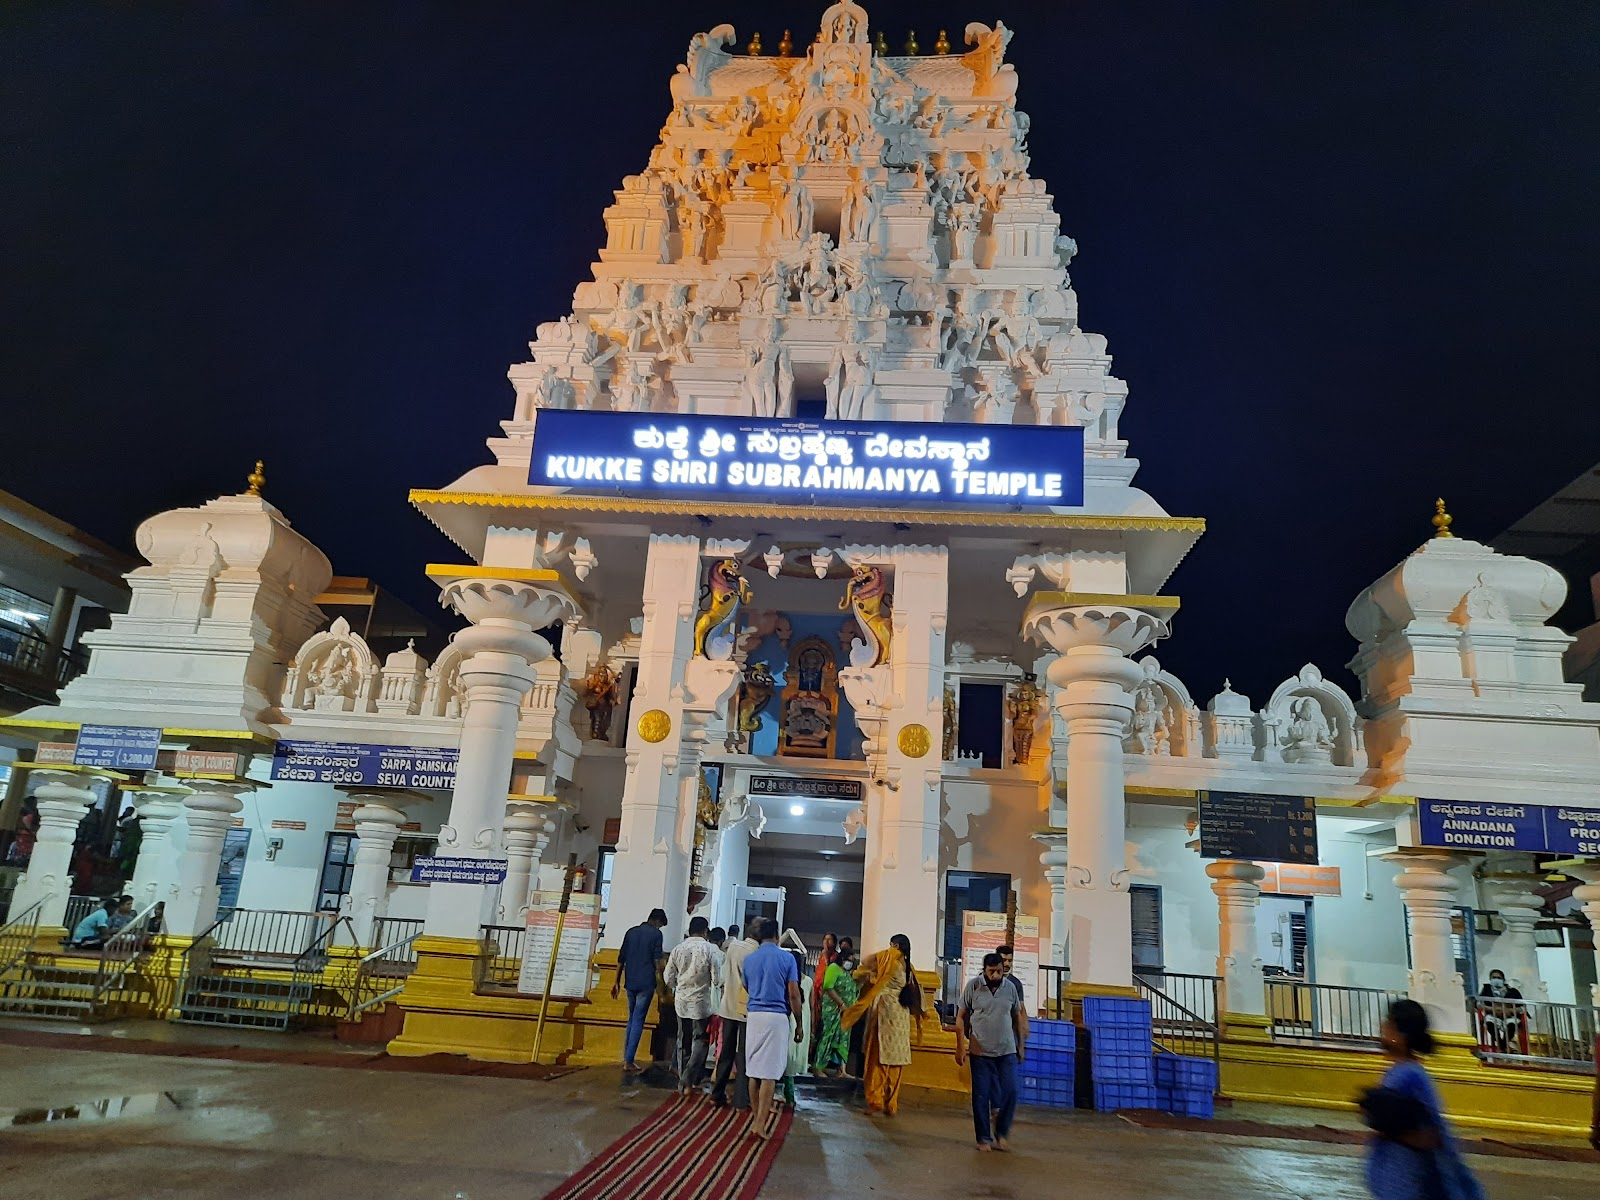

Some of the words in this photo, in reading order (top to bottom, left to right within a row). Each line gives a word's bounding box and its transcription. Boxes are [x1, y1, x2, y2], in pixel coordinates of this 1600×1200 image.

[633, 425, 689, 459] ಕುಕ್ಕೆ
[699, 428, 736, 457] ಶ್ರೀ
[747, 430, 853, 465] ಸುಬ್ರಹ್ಮಣ್ಯ
[865, 433, 990, 470] ದೇವಸ್ಥಾನ
[546, 455, 643, 482] KUKKE
[652, 459, 718, 485] SHRI
[727, 460, 941, 493] SUBRAHMANYA
[951, 470, 1062, 497] TEMPLE
[206, 756, 235, 769] COUNTER
[380, 758, 411, 771] SARPA
[277, 765, 316, 780] ಸೇವಾ
[377, 772, 406, 786] SEVA
[1430, 804, 1481, 819] ಅನ್ನದಾನ
[1442, 820, 1516, 833] ANNADANA
[1444, 833, 1515, 846] DONATION
[1570, 828, 1600, 840] PRO
